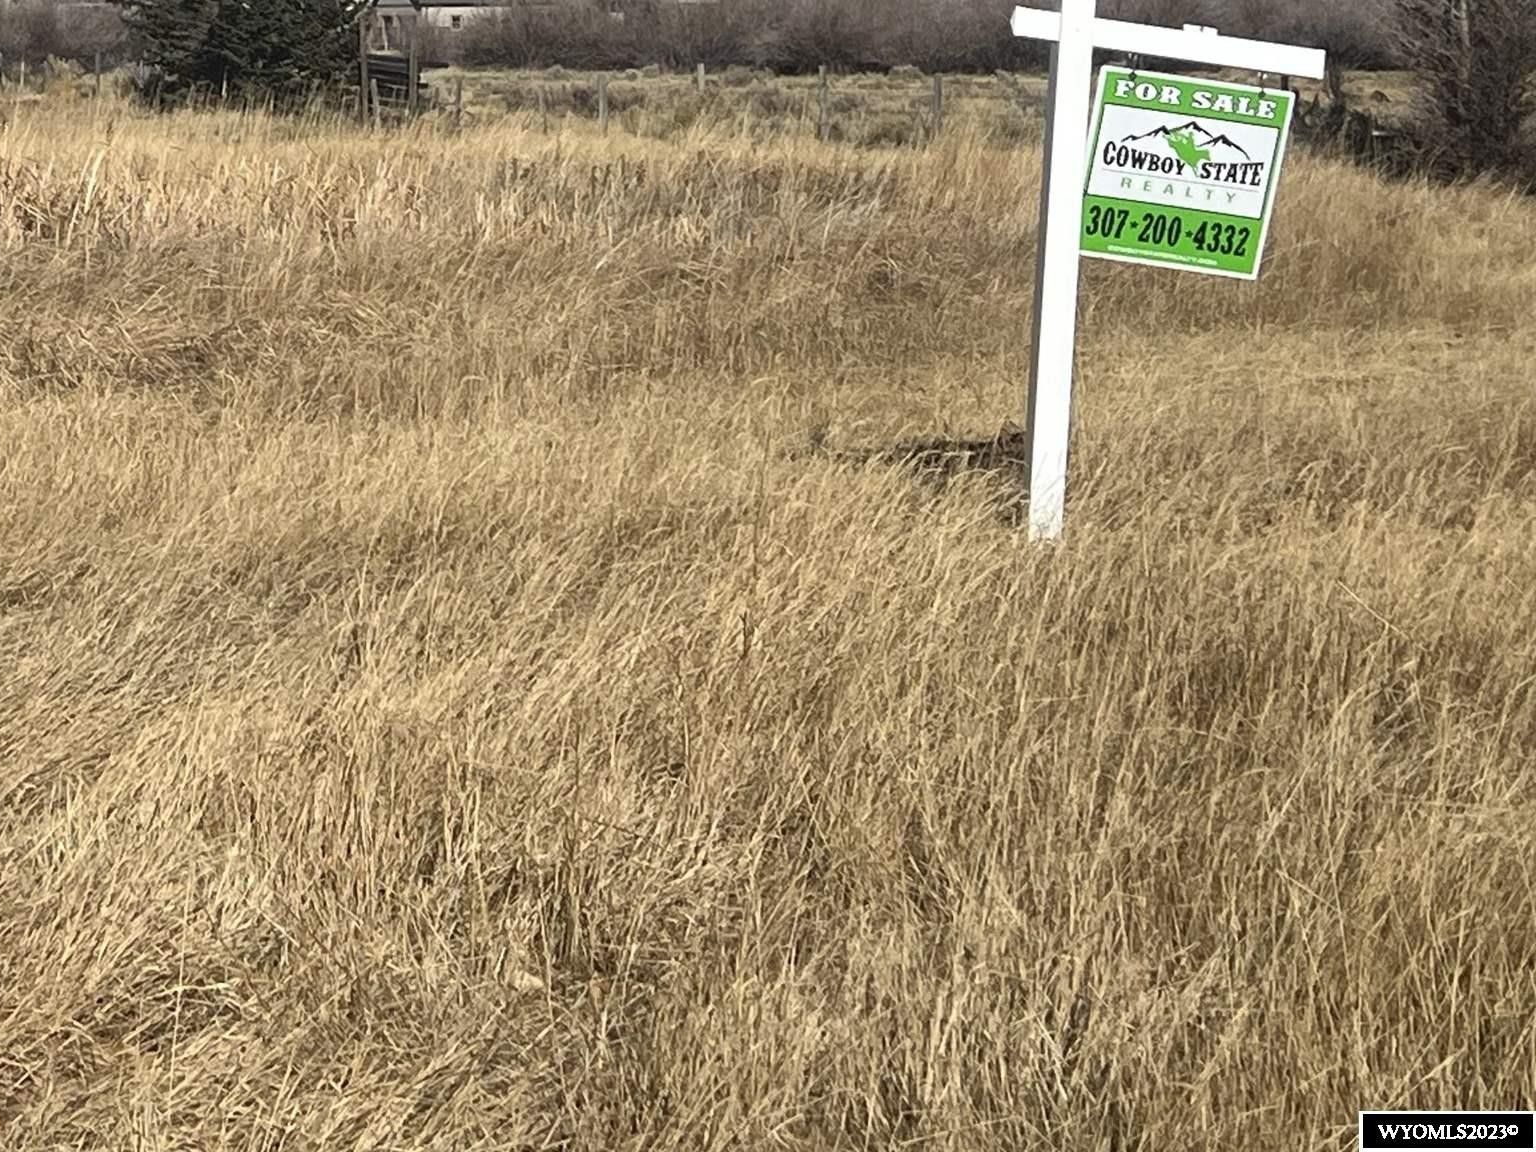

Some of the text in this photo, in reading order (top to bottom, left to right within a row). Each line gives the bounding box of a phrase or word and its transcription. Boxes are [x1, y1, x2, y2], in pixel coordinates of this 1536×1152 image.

[1114, 79, 1277, 119] FOR SALE
[1103, 141, 1264, 186] COWBOY STATE
[1121, 176, 1236, 204] REALTY
